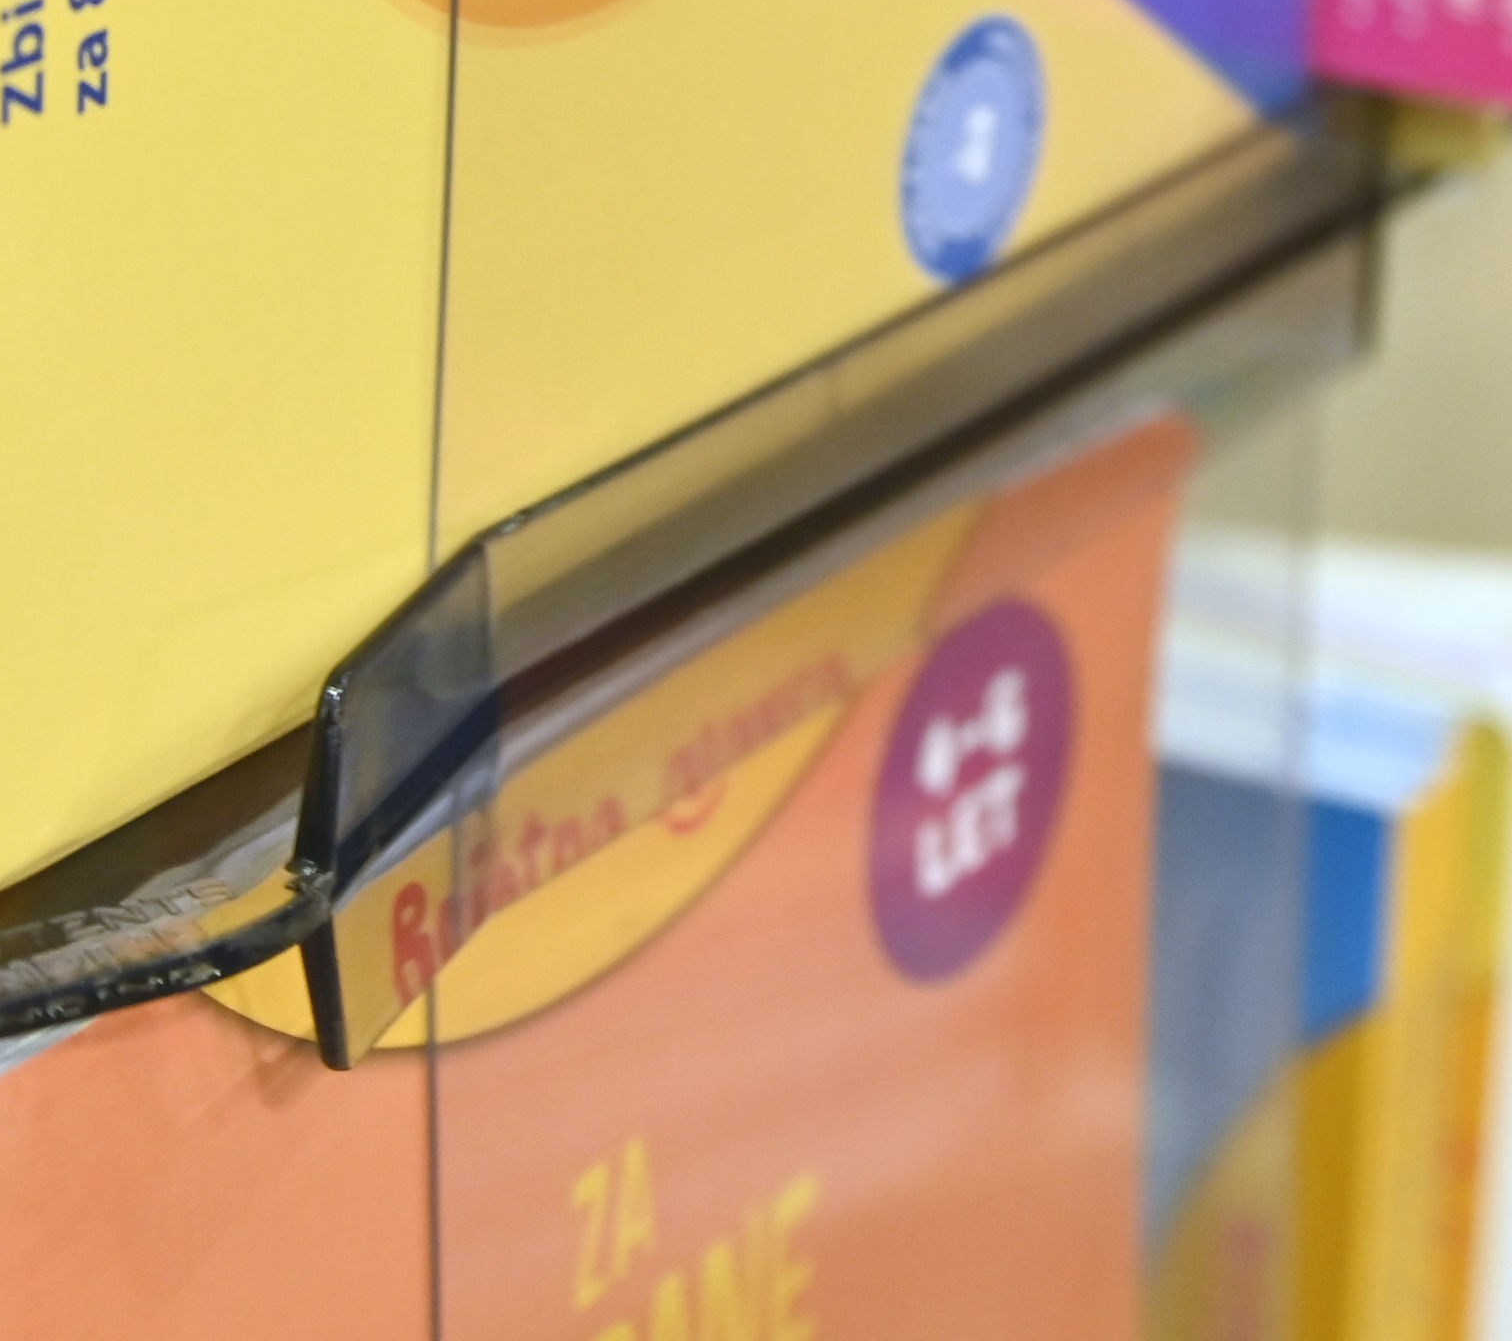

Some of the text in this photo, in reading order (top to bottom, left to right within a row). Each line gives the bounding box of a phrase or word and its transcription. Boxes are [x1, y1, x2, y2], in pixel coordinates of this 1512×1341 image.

[76, 28, 111, 116] za
[914, 760, 1028, 897] LET
[571, 1135, 658, 1311] ZA
